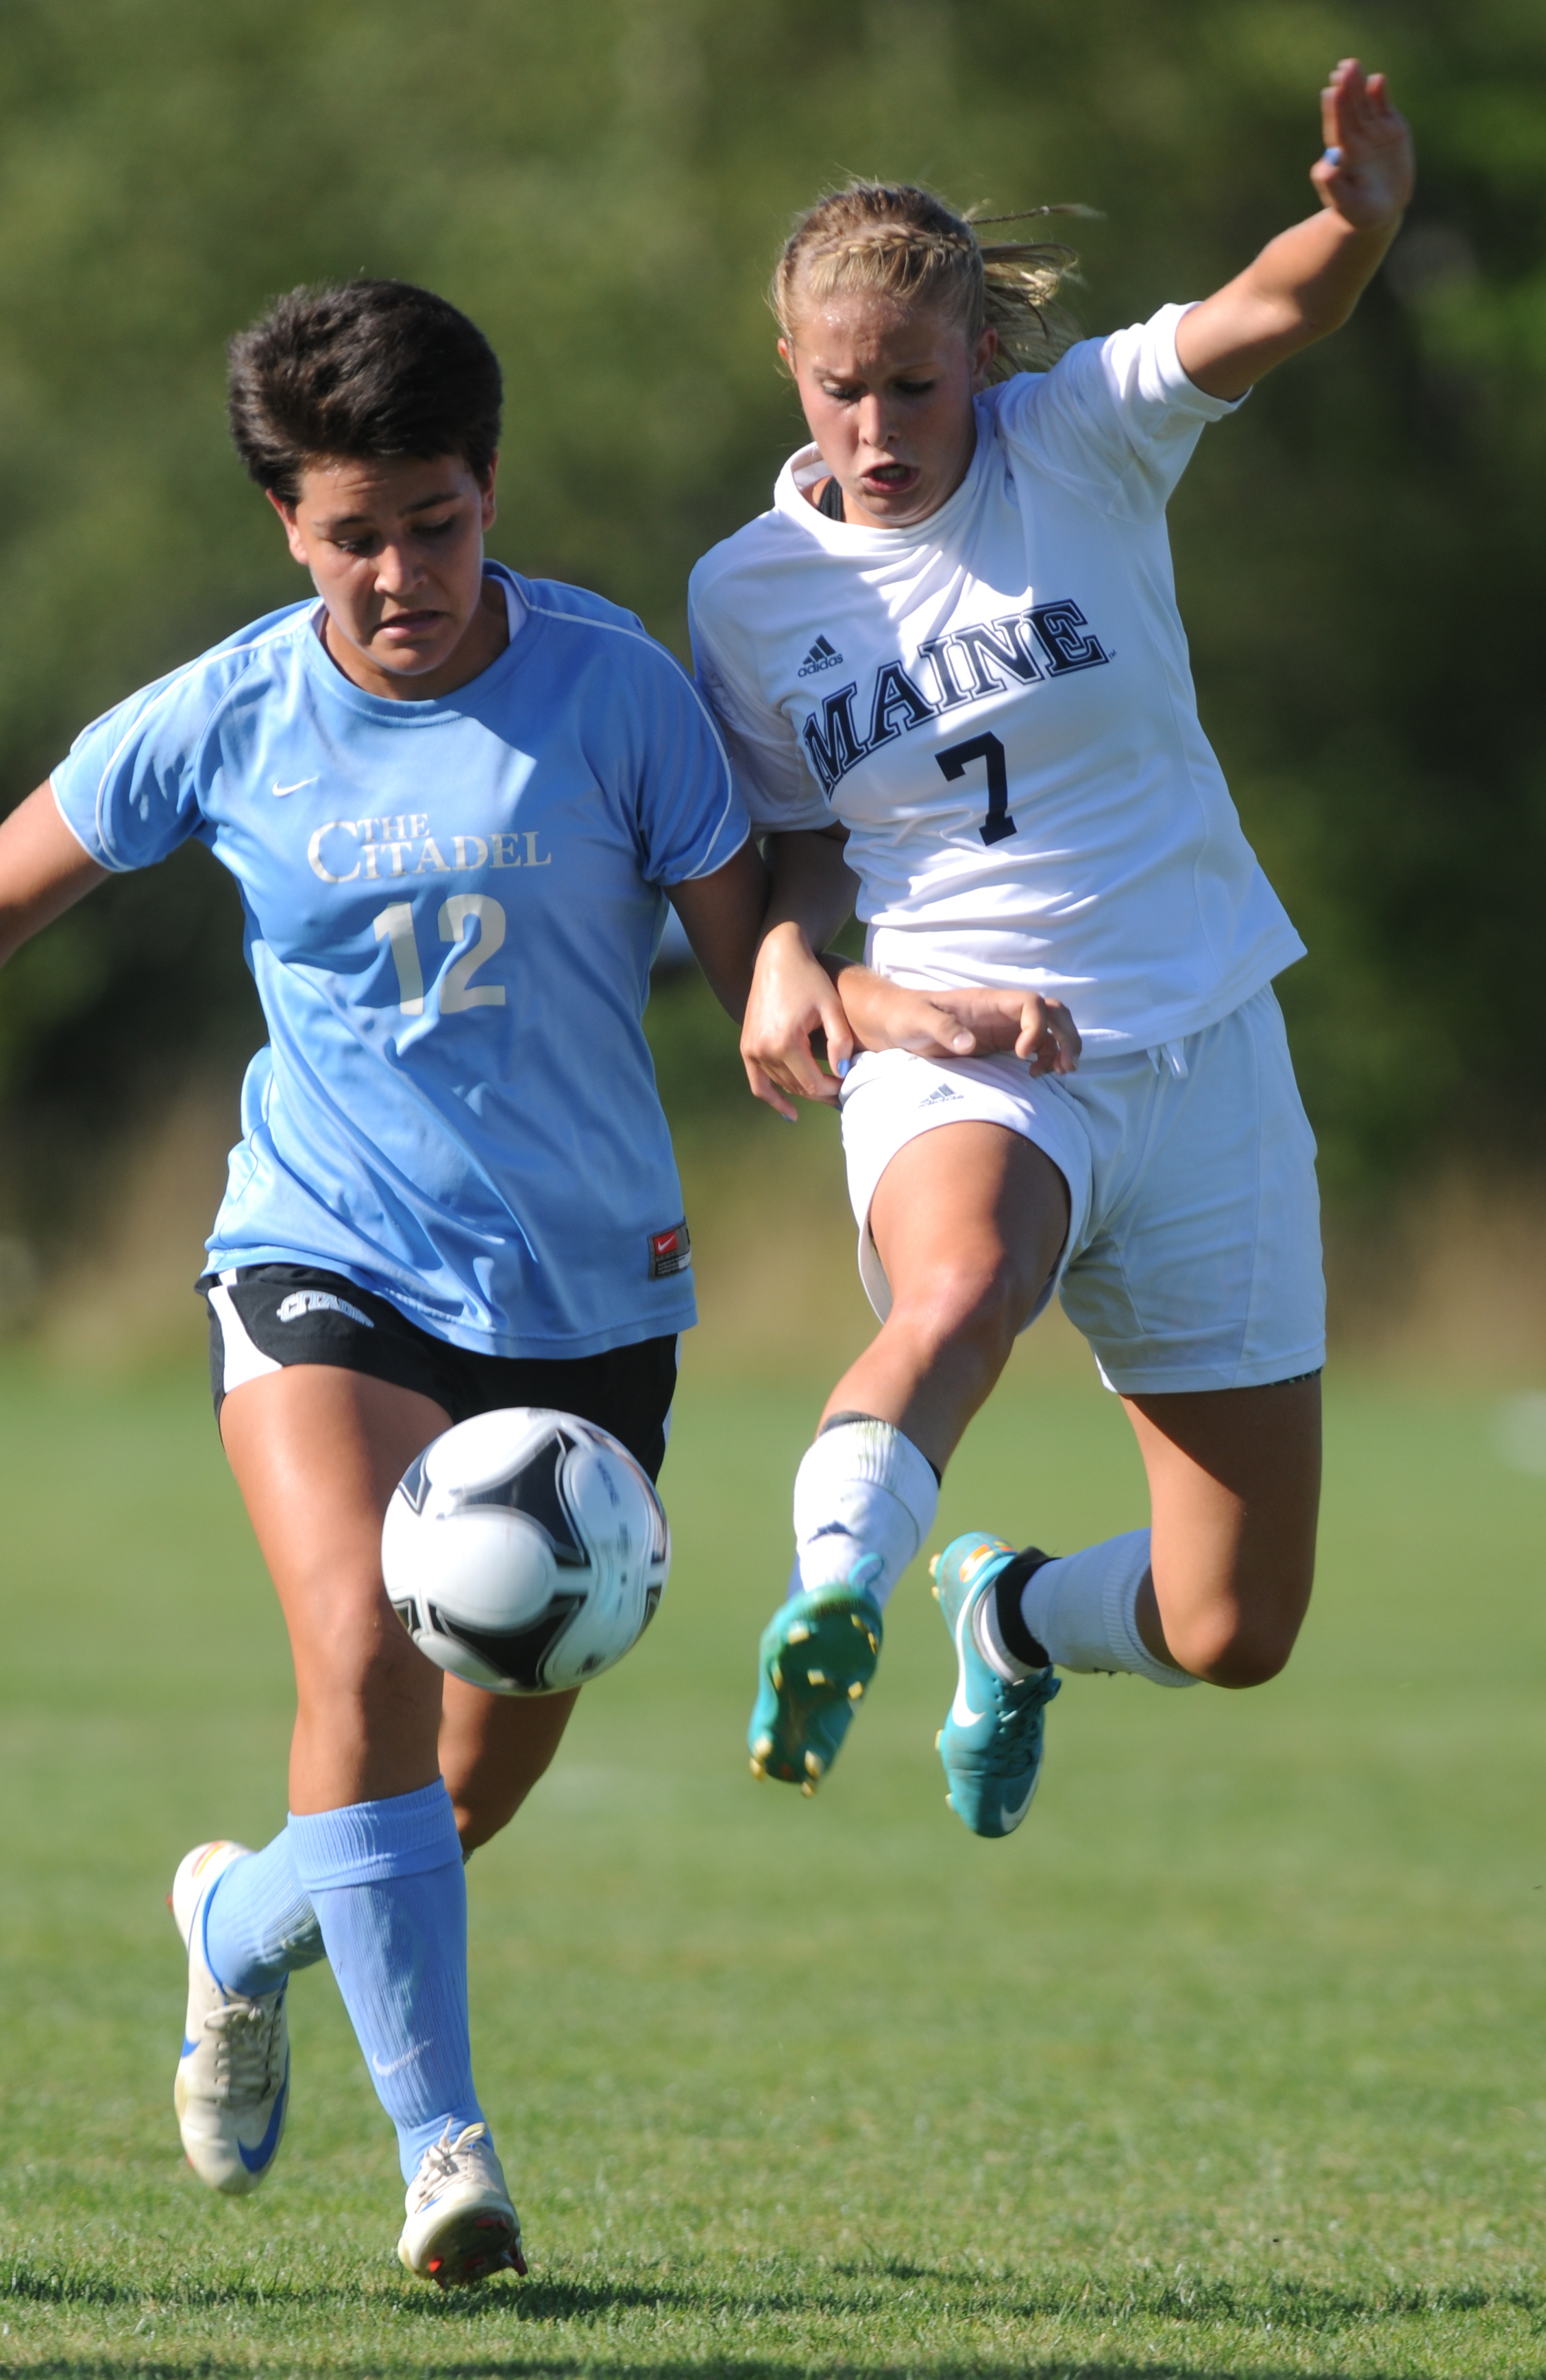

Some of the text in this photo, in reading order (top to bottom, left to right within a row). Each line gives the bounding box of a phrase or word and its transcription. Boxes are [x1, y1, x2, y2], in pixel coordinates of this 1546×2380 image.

[798, 653, 844, 677] adidas
[802, 598, 1109, 802] MAINE
[357, 814, 430, 843] THE
[934, 731, 1018, 846] 7
[307, 821, 552, 884] CITADEL
[373, 893, 506, 1016] 12
